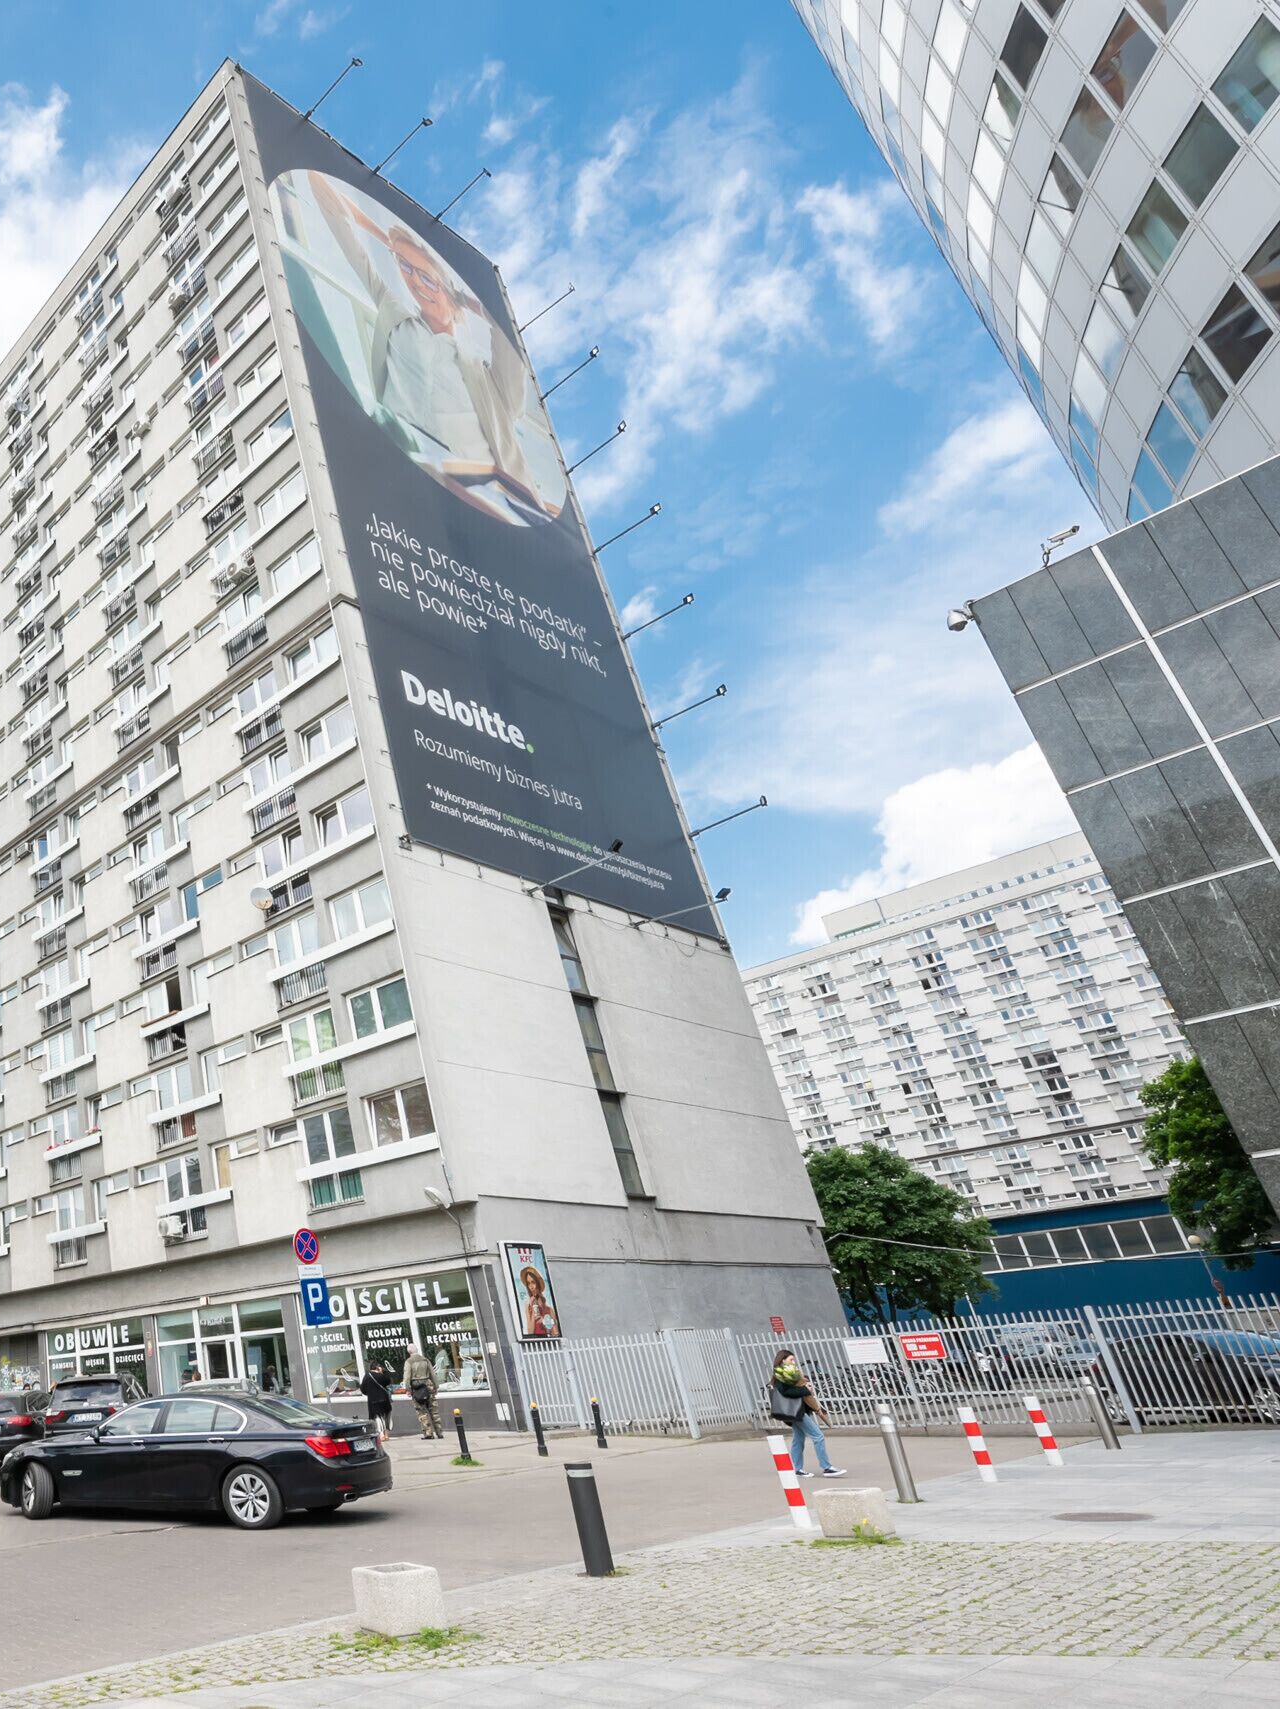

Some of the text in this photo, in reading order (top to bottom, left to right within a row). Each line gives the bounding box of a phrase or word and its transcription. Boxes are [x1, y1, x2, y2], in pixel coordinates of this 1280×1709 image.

[366, 513, 422, 556] „Jakie
[428, 547, 491, 593] proste
[495, 581, 516, 606] te
[520, 596, 586, 642] podatki”
[378, 569, 411, 600] ale
[370, 540, 607, 678] nie powiedział nigdy nikt,
[400, 670, 535, 754] Deloitte.
[414, 729, 583, 810] Rozumiemy biznes jutra
[430, 800, 461, 819] zeznań
[462, 812, 518, 839] podatkowych.
[518, 831, 546, 851] Więcej
[545, 842, 557, 852] na
[433, 786, 501, 821] Wykorzystujemy
[502, 812, 550, 837] nowoczesne
[592, 844, 602, 856] do
[307, 1283, 323, 1311] P
[329, 1281, 449, 1317] OŚCIEL
[54, 1325, 129, 1351] OBUWIE
[367, 1327, 402, 1338] KOŁDRY
[427, 1332, 472, 1346] RĘCZNIKI
[435, 1321, 462, 1332] KOCE
[365, 1338, 409, 1349] PODUSZKI
[52, 1361, 74, 1370] DAMSKIE
[85, 1358, 105, 1367] MĘSKIE
[115, 1354, 144, 1364] DZIECIĘCE
